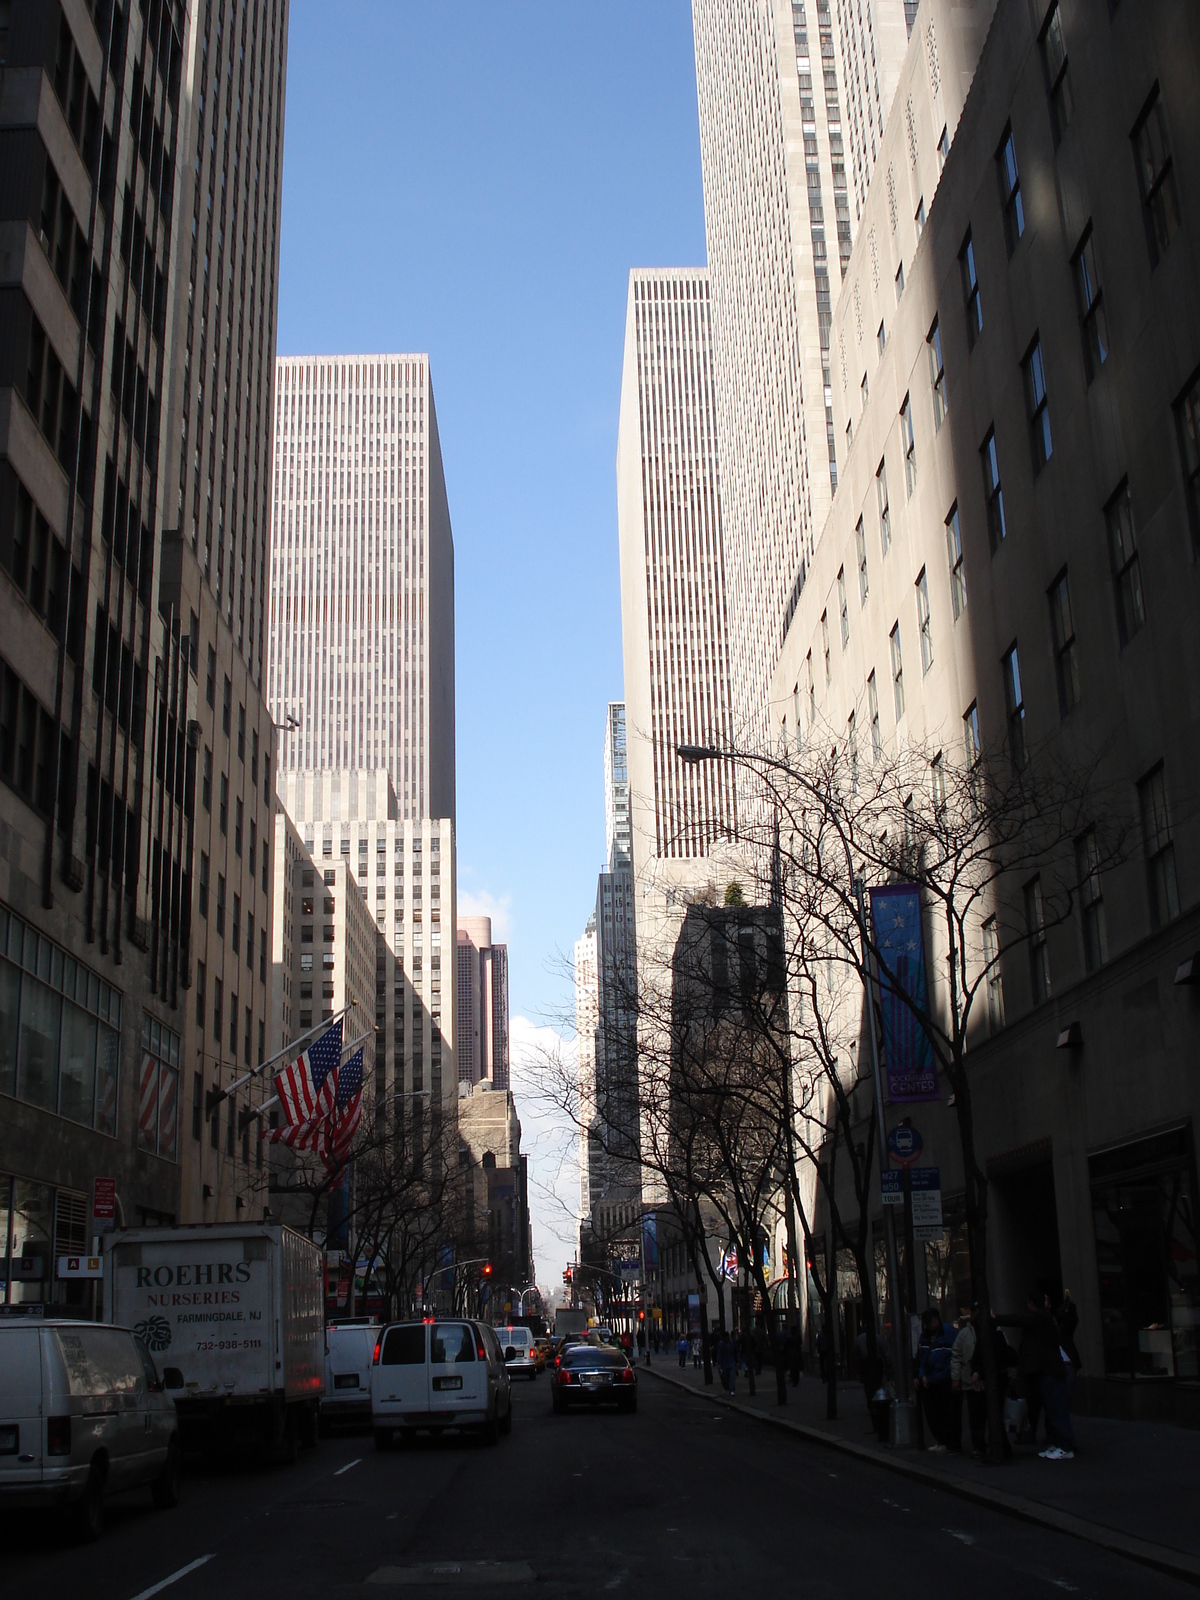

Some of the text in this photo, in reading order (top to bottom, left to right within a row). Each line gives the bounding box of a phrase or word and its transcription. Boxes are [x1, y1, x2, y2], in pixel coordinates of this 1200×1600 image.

[891, 1081, 936, 1095] CENTER
[882, 1171, 898, 1180] M27
[883, 1182, 899, 1191] M50
[884, 1195, 901, 1203] TOUR
[70, 1260, 77, 1268] A
[136, 1261, 251, 1288] ROEHRS
[147, 1291, 240, 1307] NURSERIES
[177, 1311, 262, 1324] FARMINGDALE, NJ
[196, 1340, 262, 1351] 732-938-5111
